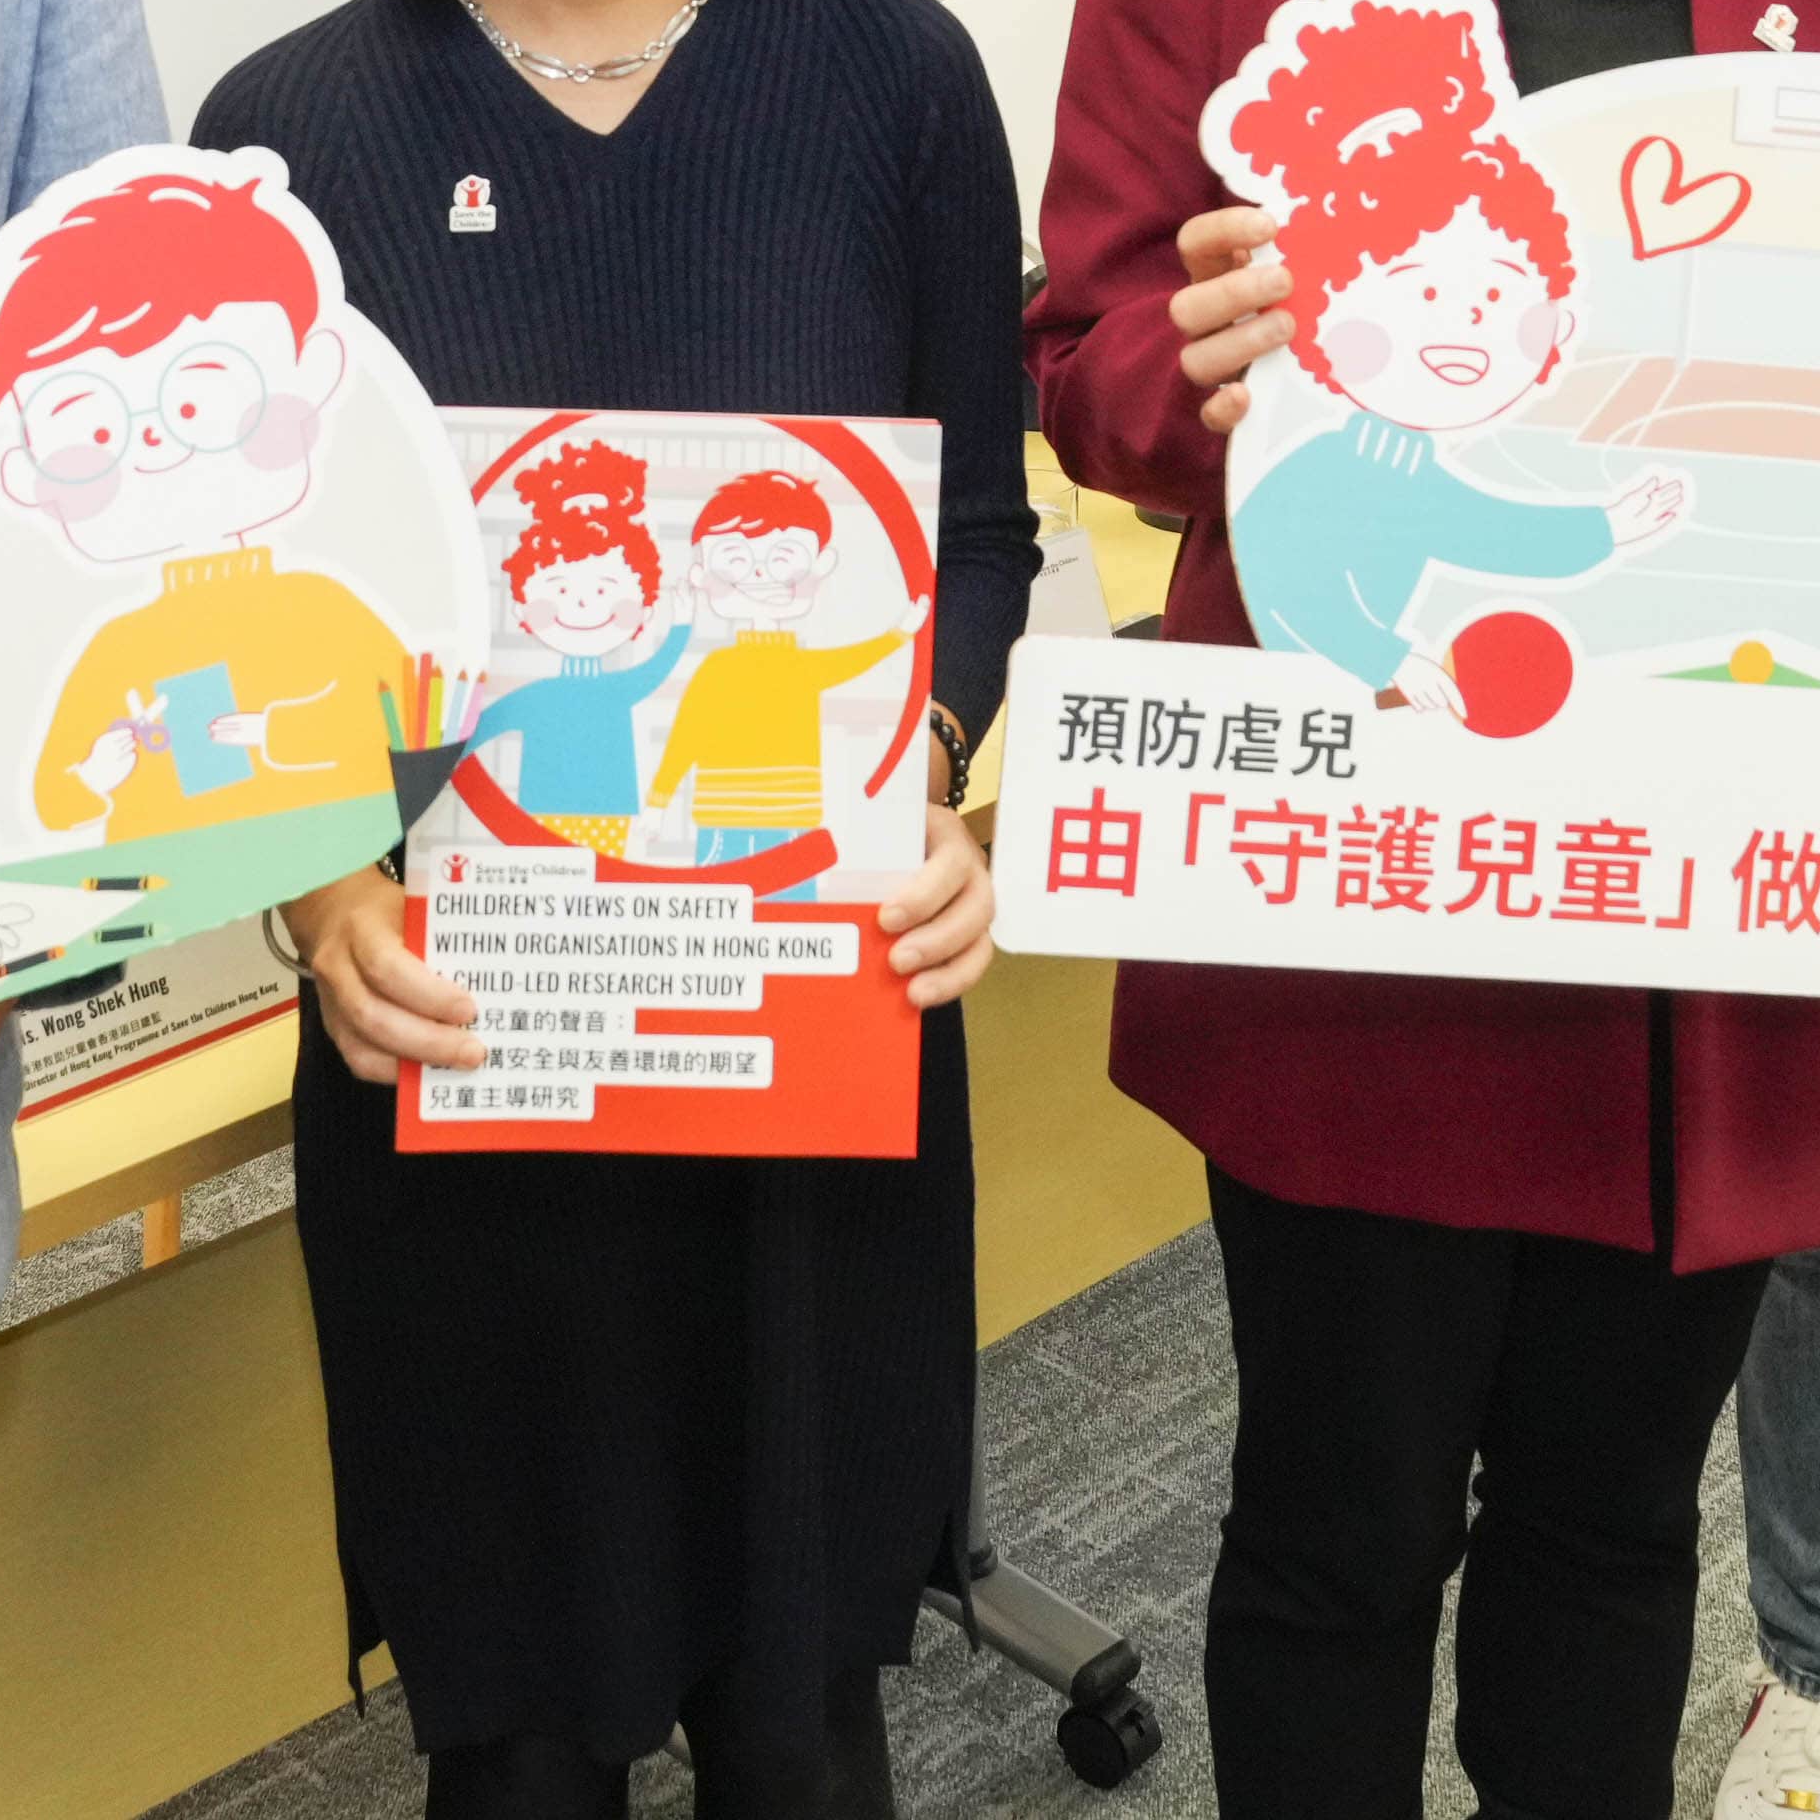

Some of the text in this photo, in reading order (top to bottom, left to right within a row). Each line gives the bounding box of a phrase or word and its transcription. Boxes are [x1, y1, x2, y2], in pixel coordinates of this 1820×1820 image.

[1057, 691, 1358, 779] 預防虐兒
[530, 864, 587, 877] Children
[435, 893, 739, 920] CHILDREN'S VIEWS ON SAFETY
[435, 932, 833, 960] WITHIN ORGANISATIONS IN HONG KONG
[569, 973, 674, 996] RESEARCH
[682, 975, 747, 997] STUDY
[41, 1010, 86, 1037] Wong
[87, 992, 125, 1019] Shek
[127, 976, 170, 1004] Hung
[60, 1065, 68, 1077] of
[70, 1059, 91, 1073] Hong
[92, 1049, 113, 1065] Kong
[114, 1032, 160, 1054] Programme
[171, 1019, 189, 1034] Save
[190, 1012, 203, 1024] the
[205, 1000, 237, 1018] Children
[238, 991, 259, 1006] Hong
[259, 981, 279, 997] Kong
[431, 1047, 757, 1075] 構安全與友善環境的期望
[430, 1085, 579, 1110] 兒童主導研究
